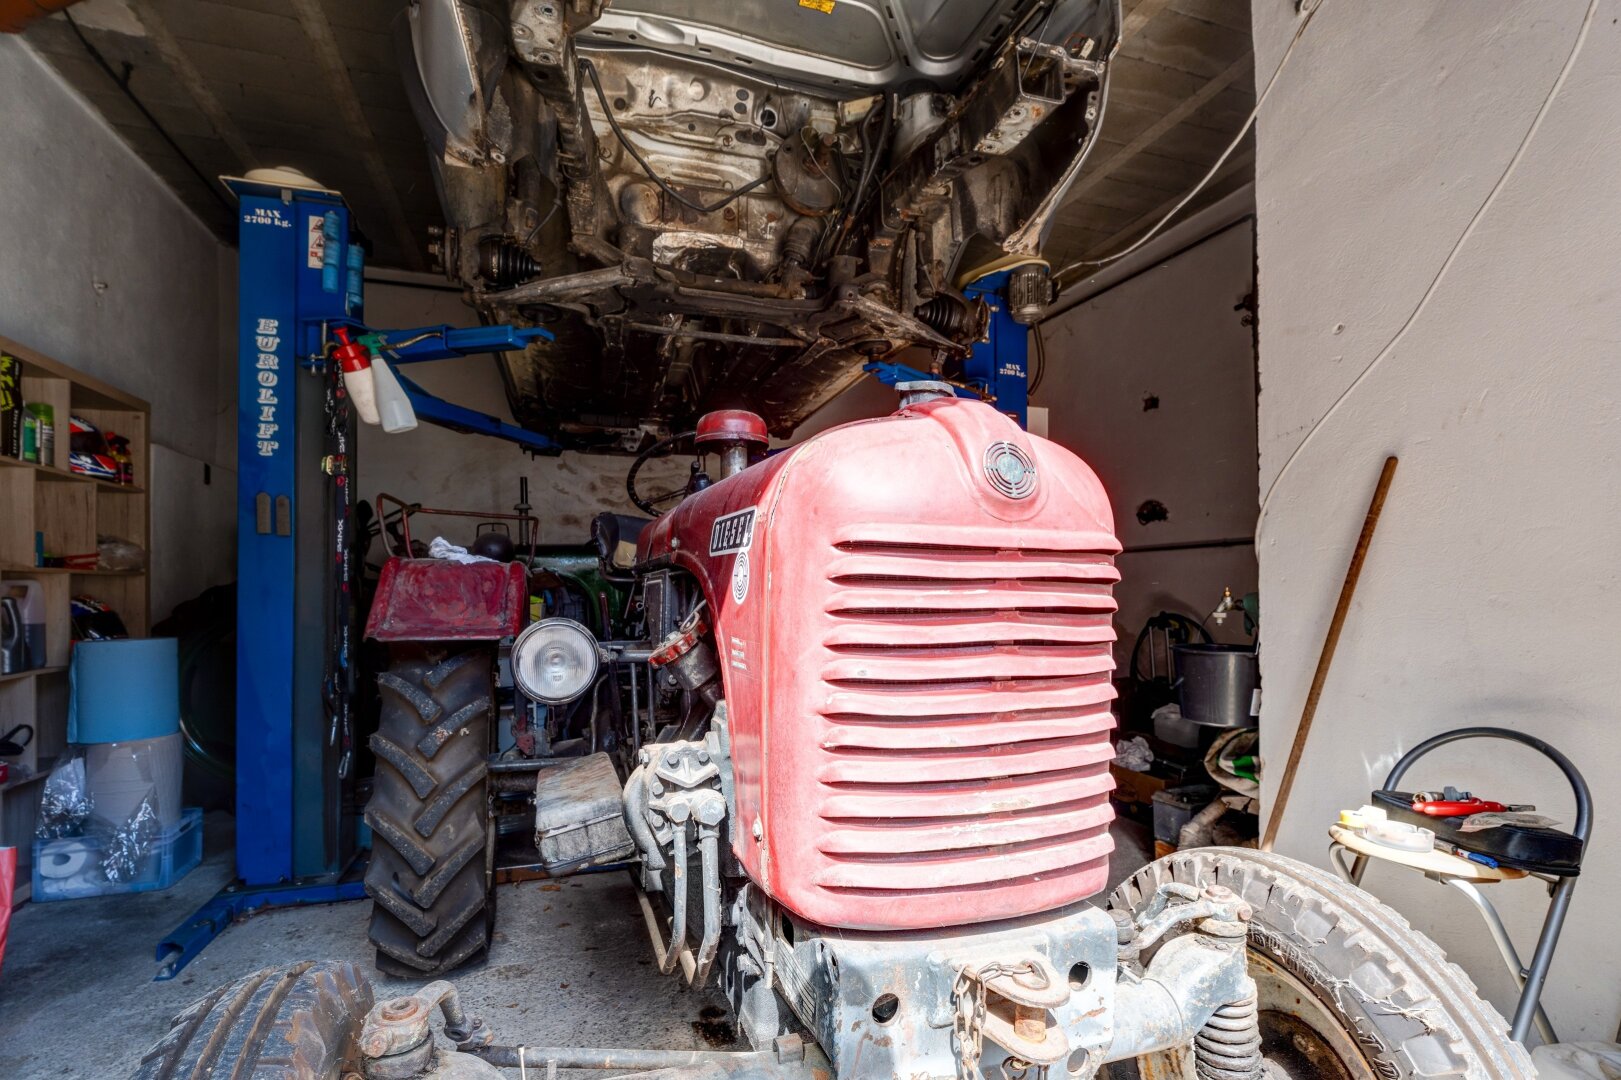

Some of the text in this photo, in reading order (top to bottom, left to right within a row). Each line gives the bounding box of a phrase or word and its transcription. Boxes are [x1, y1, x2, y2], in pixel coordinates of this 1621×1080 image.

[254, 208, 281, 219] MAX
[243, 215, 272, 225] 2700
[1005, 362, 1021, 371] MAX
[999, 368, 1016, 376] 2700
[255, 318, 280, 456] EUROLIFT
[712, 513, 752, 550] DIESEL
